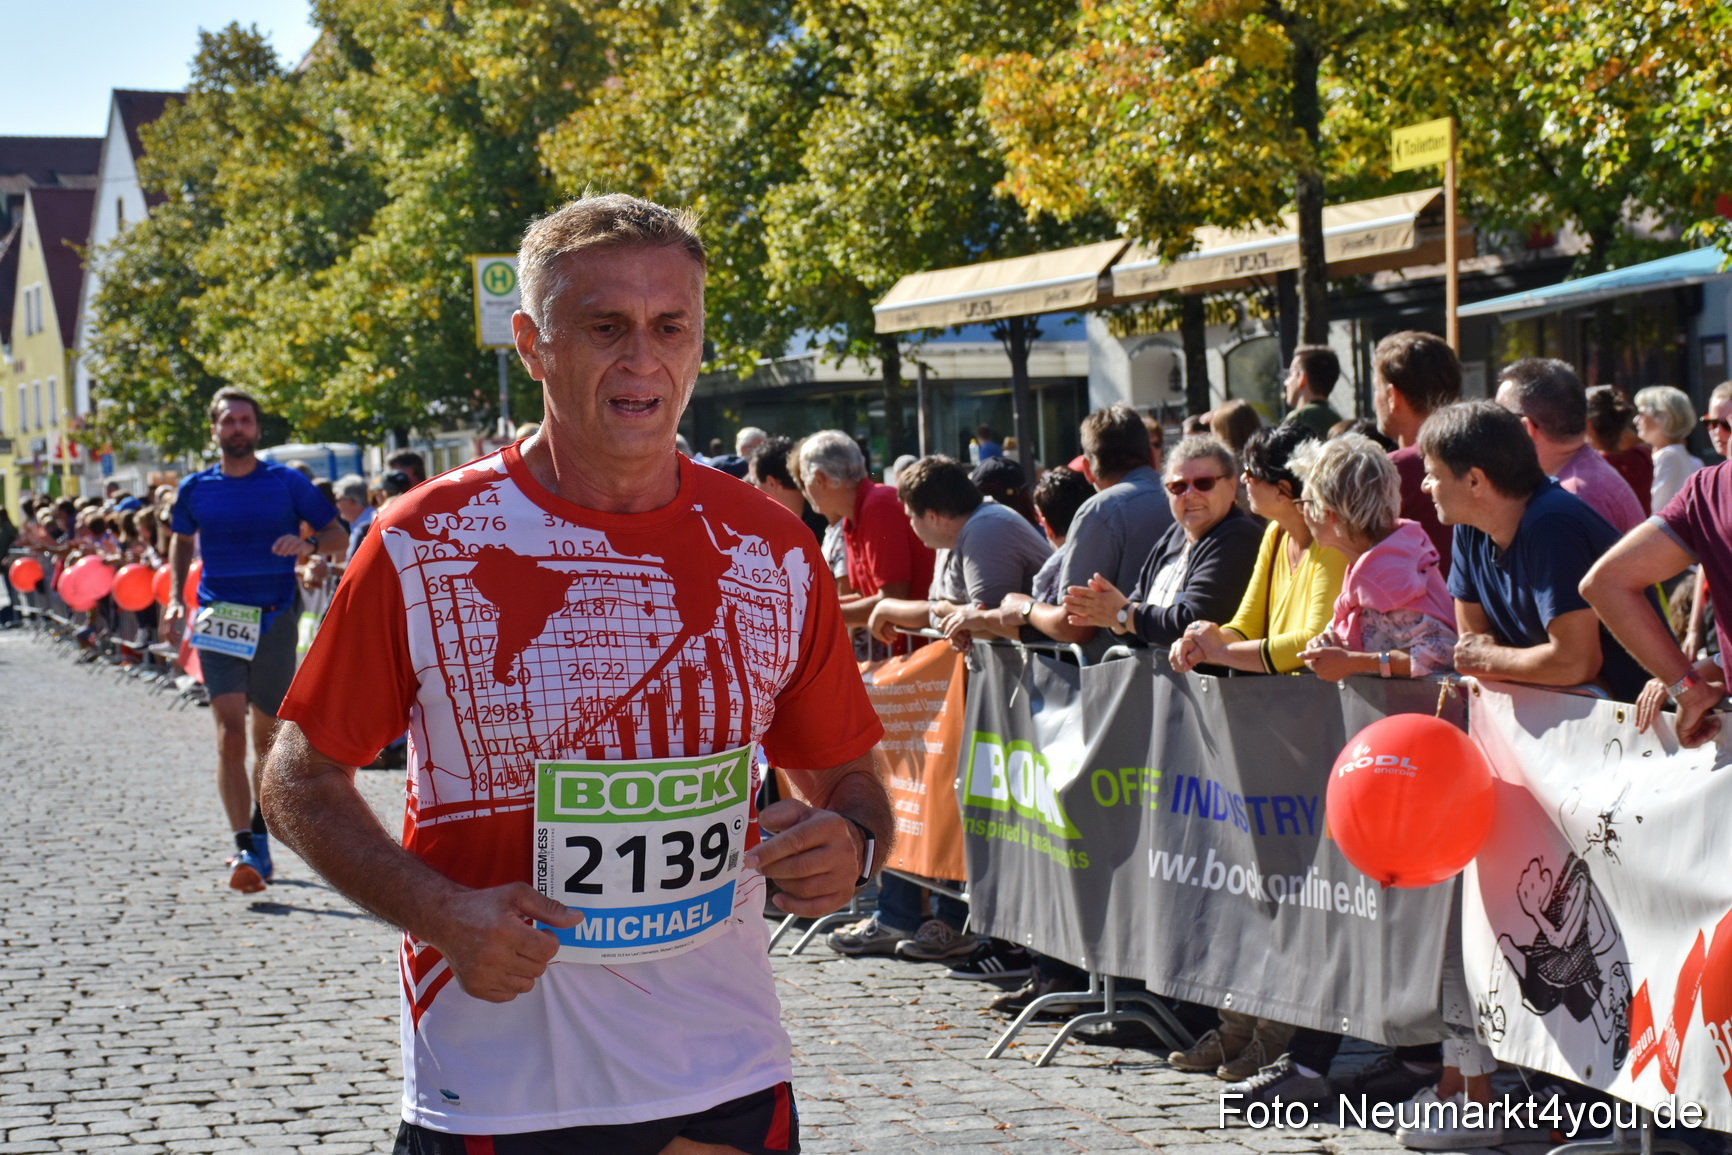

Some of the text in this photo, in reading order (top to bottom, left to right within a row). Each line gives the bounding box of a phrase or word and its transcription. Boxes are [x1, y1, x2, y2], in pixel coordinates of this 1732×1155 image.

[1404, 136, 1447, 156] Toiletten
[548, 539, 609, 557] 10.54
[214, 605, 252, 619] OCK
[560, 599, 617, 617] 24.87
[202, 618, 250, 642] 2164
[563, 630, 622, 649] 52.01
[567, 662, 625, 681] 26.22
[556, 757, 739, 815] BOCK
[564, 822, 730, 896] 2139
[574, 902, 714, 941] MICHAEL
